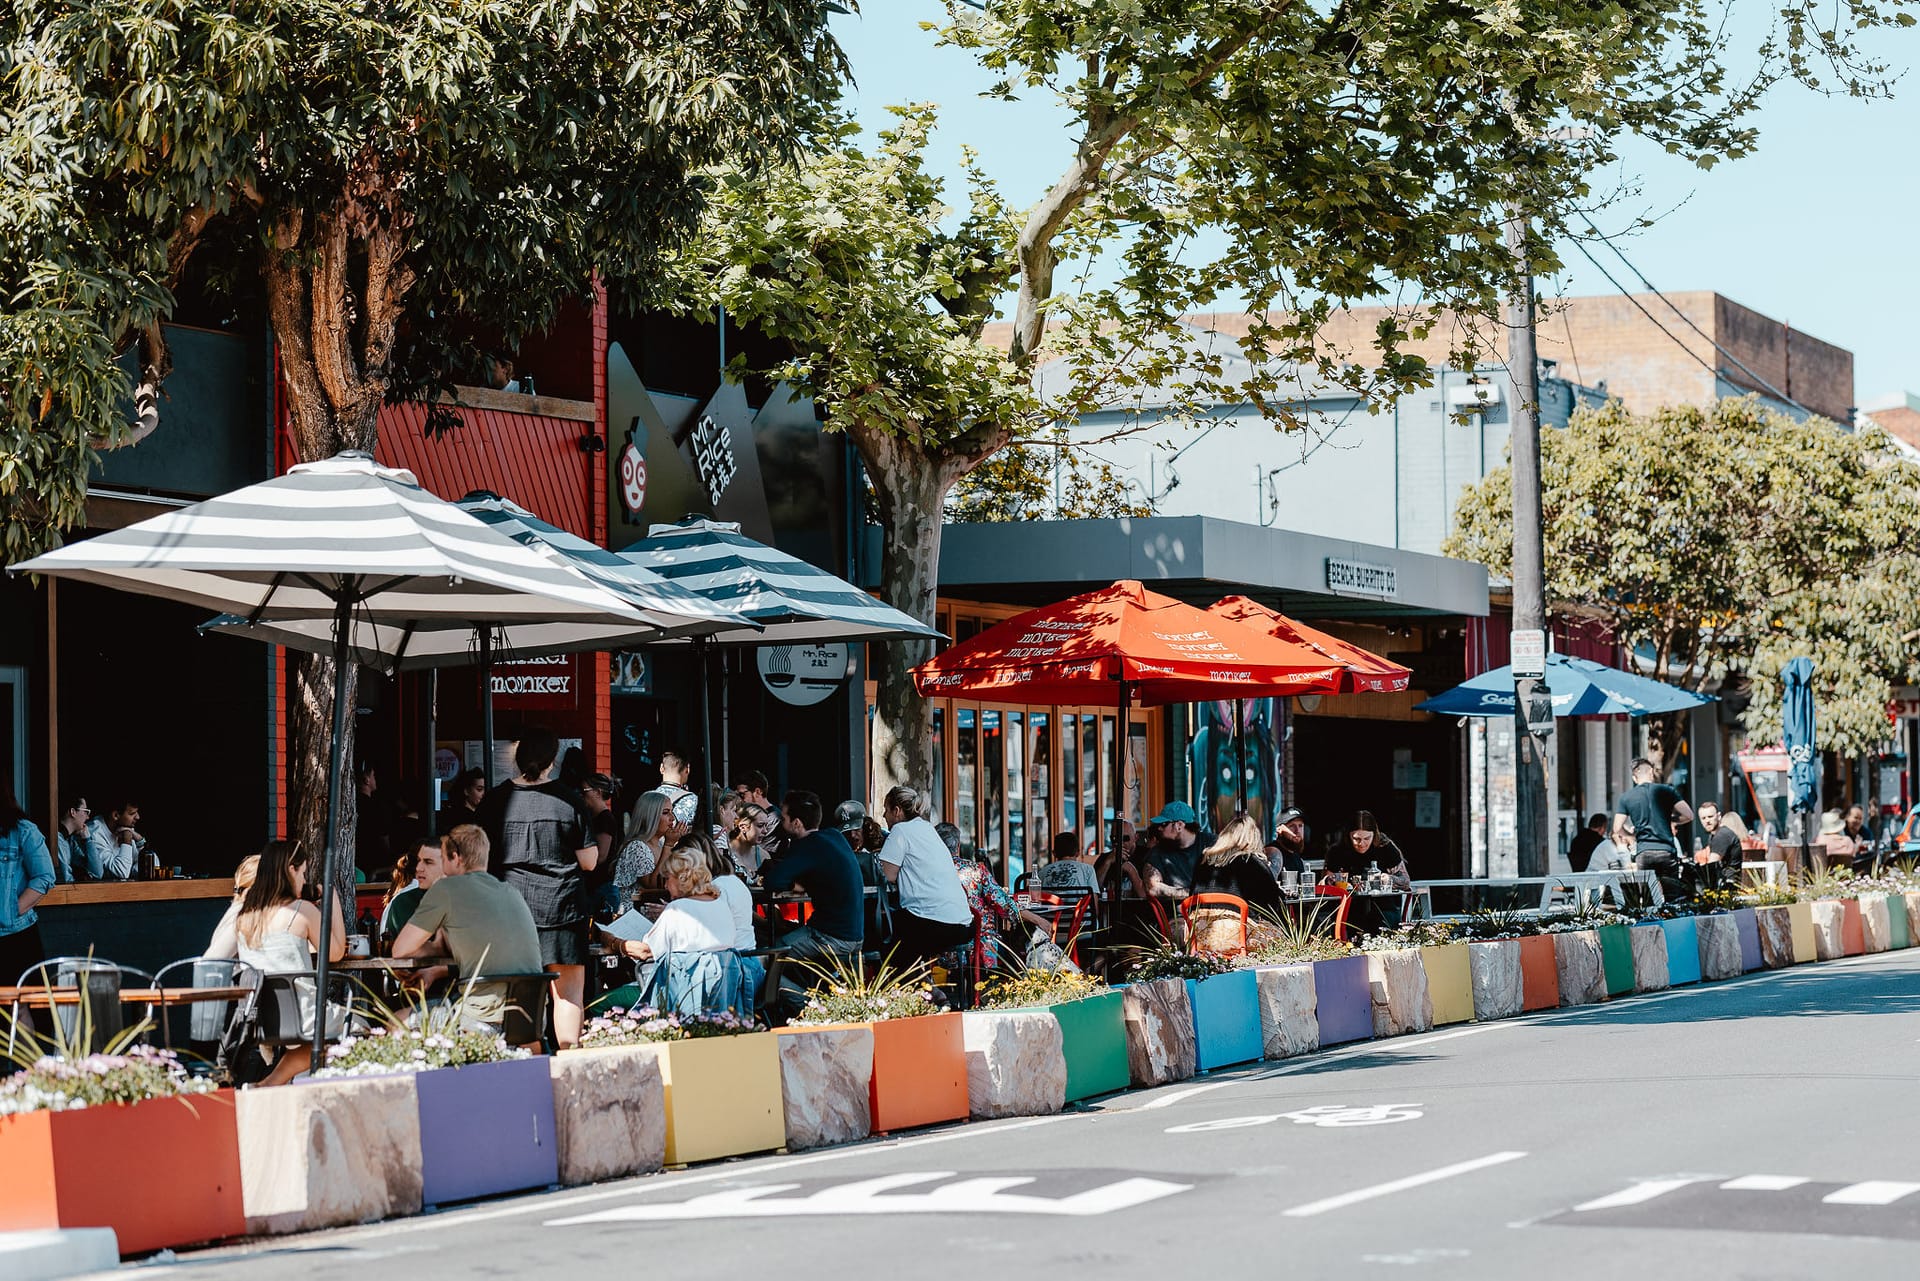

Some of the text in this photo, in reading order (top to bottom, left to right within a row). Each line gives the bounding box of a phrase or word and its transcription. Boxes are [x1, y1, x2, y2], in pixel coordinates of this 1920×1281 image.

[1331, 562, 1395, 593] BEACH BURRITO CO
[490, 675, 571, 694] monkey
[1209, 670, 1251, 682] monkey
